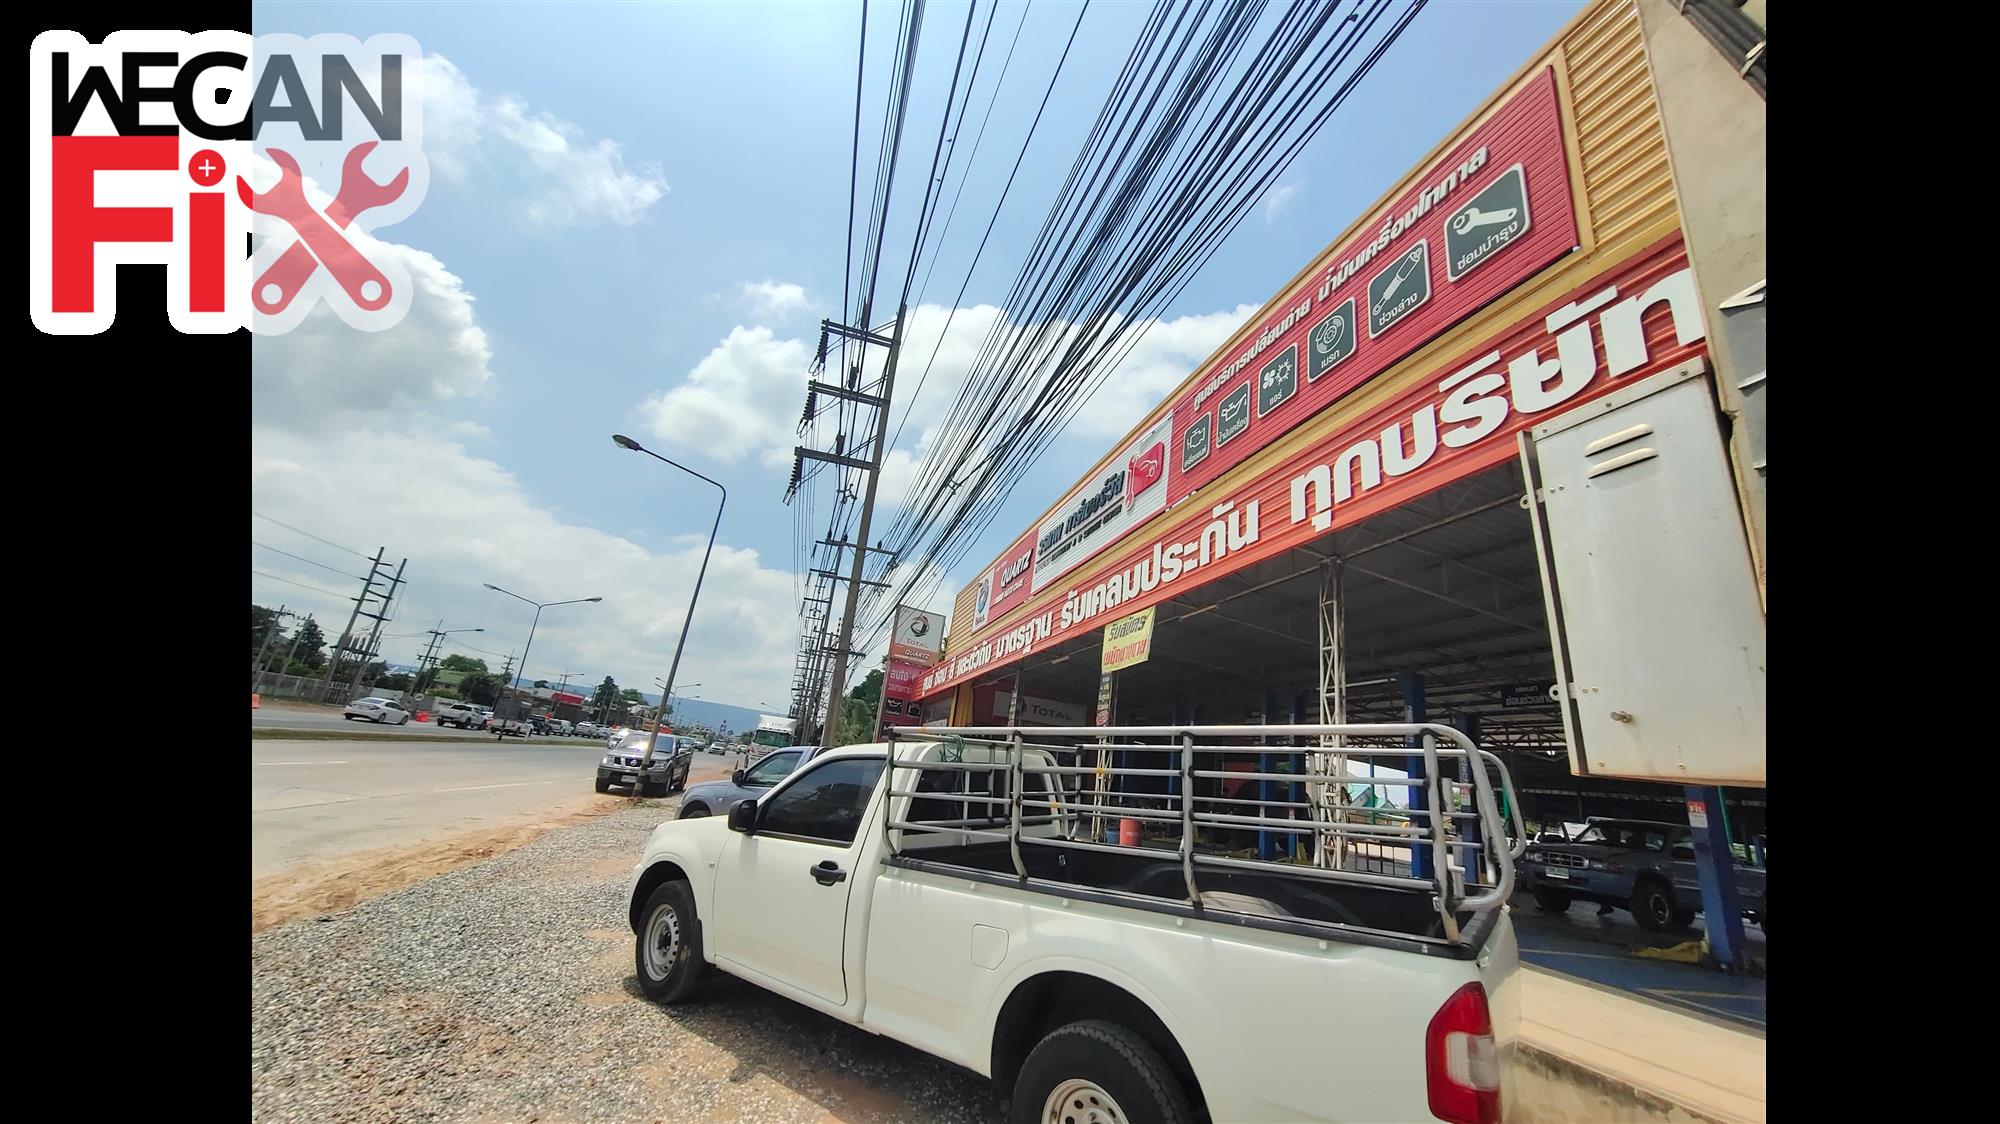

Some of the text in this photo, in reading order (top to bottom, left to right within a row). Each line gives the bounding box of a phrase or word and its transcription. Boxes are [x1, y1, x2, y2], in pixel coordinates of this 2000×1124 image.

[1456, 220, 1518, 270] ซ่อมบำรุง
[1379, 292, 1418, 326] ช่วงล่าง
[1269, 389, 1283, 406] แอร์
[995, 611, 1053, 655] มาตรฐาน
[1060, 499, 1260, 630] รับเคลมประกัน
[1290, 267, 1706, 533] ทุกบริษัท
[1000, 548, 1033, 588] QUARTZ
[1108, 615, 1148, 642] รับสมัคร
[904, 649, 930, 660] QUARTZ
[1031, 704, 1072, 720] TOTAL
